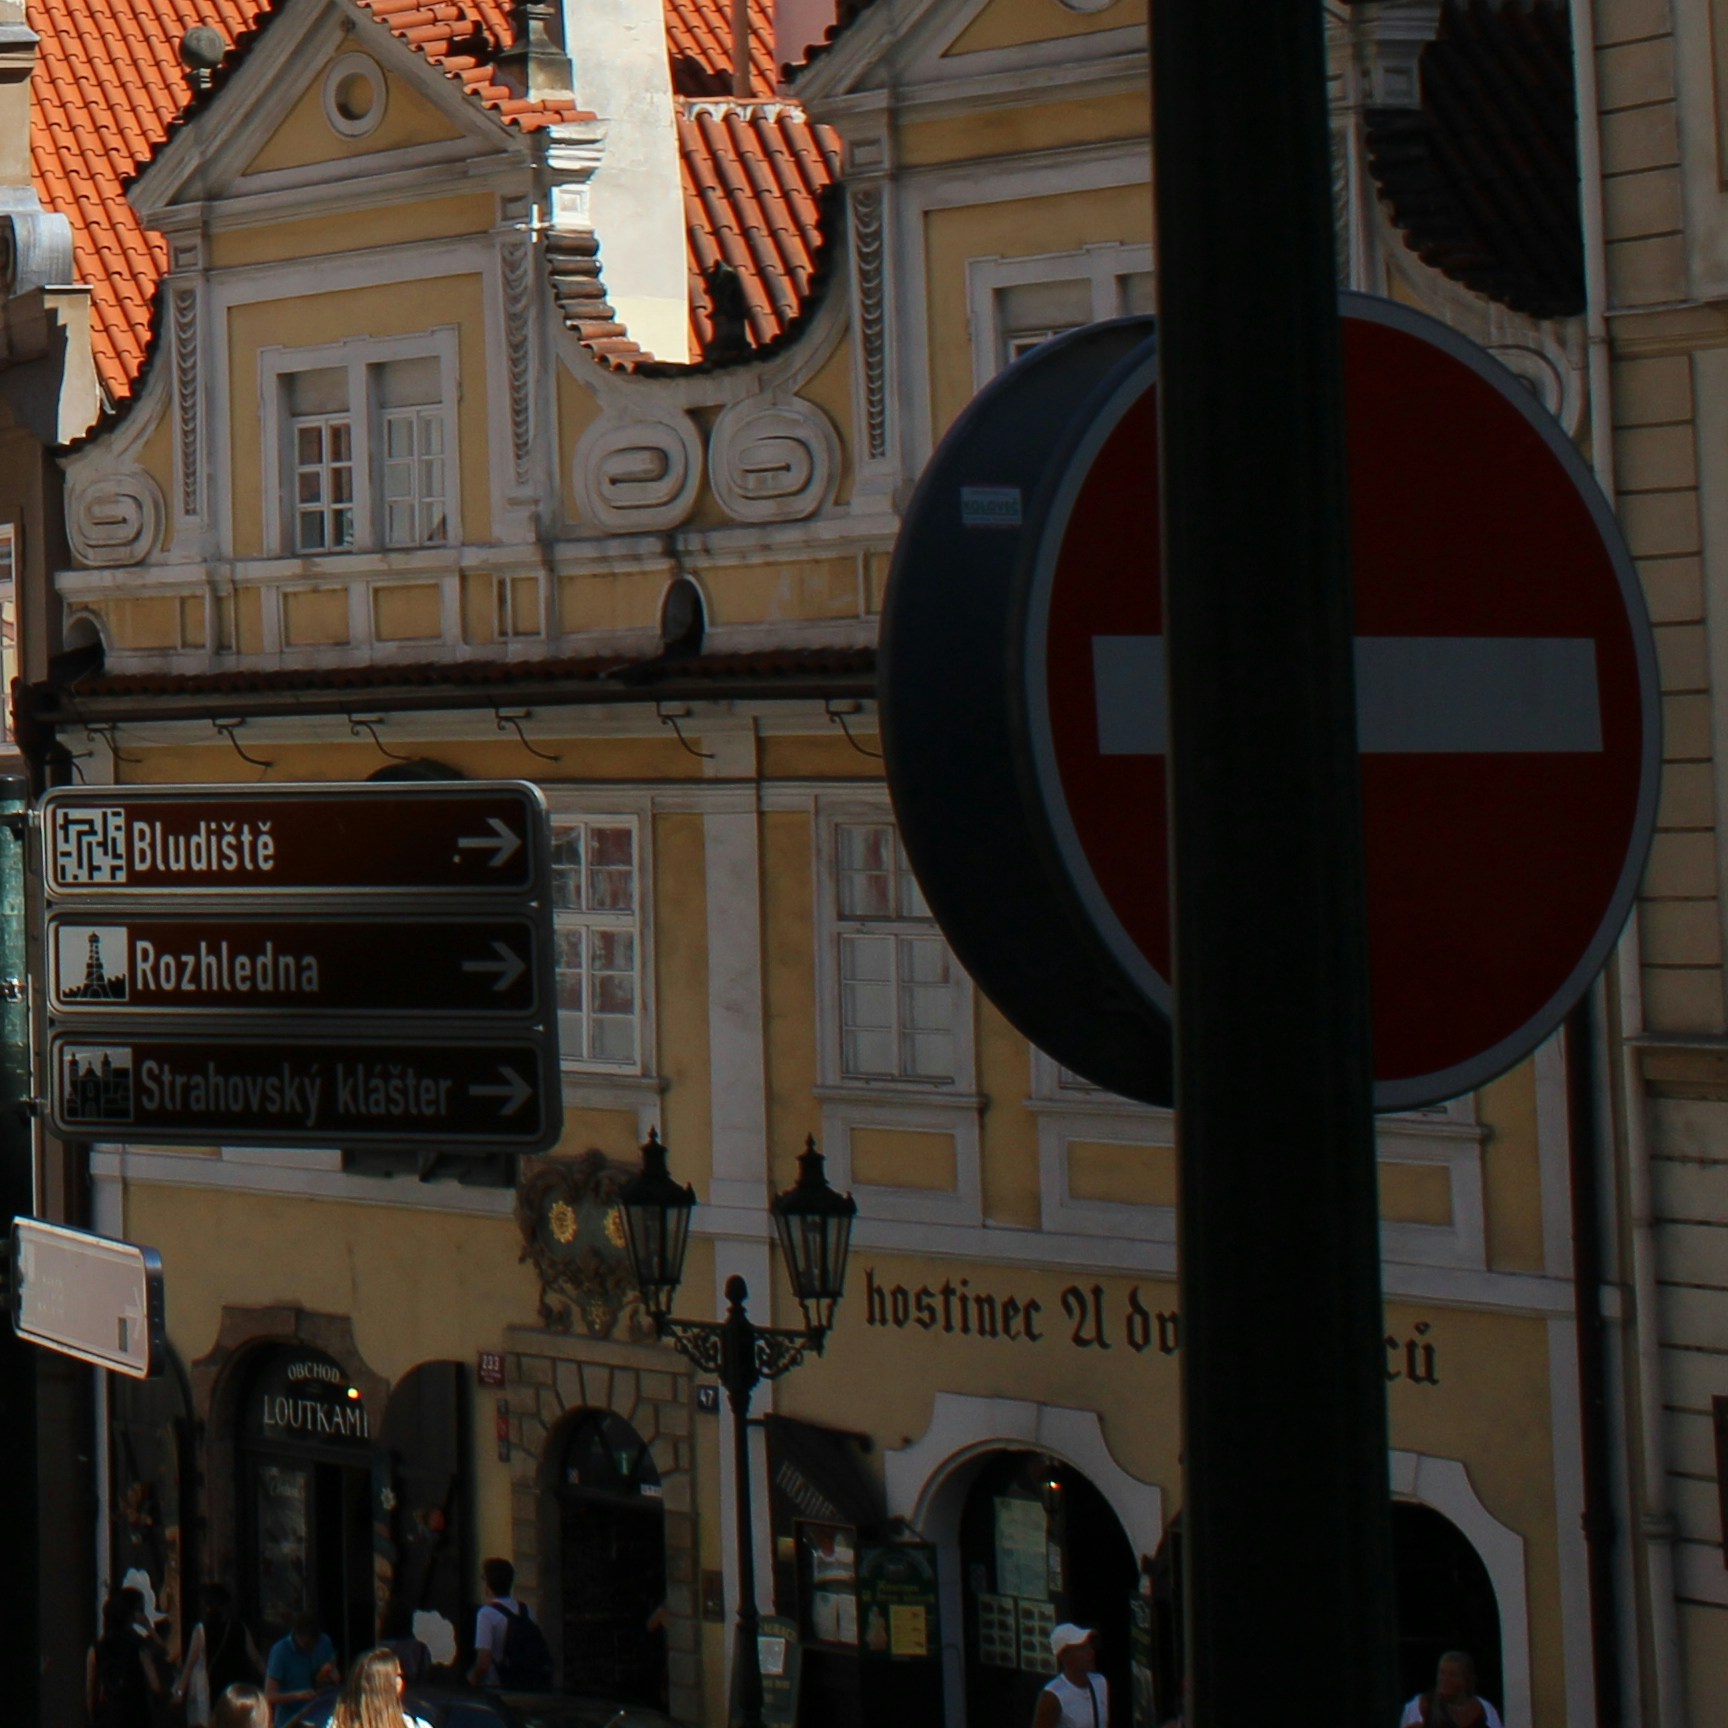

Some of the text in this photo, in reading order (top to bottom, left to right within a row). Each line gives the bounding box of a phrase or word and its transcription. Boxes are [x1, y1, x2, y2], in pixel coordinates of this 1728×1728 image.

[132, 820, 276, 871] Bludiště
[134, 940, 320, 993] Rozhledna
[141, 1059, 452, 1128] Strahovský klášter
[864, 1267, 1043, 1342] hostinec
[287, 1361, 340, 1384] OBCHOD
[700, 1387, 714, 1407] 47
[264, 1394, 369, 1439] LOUTKAMI
